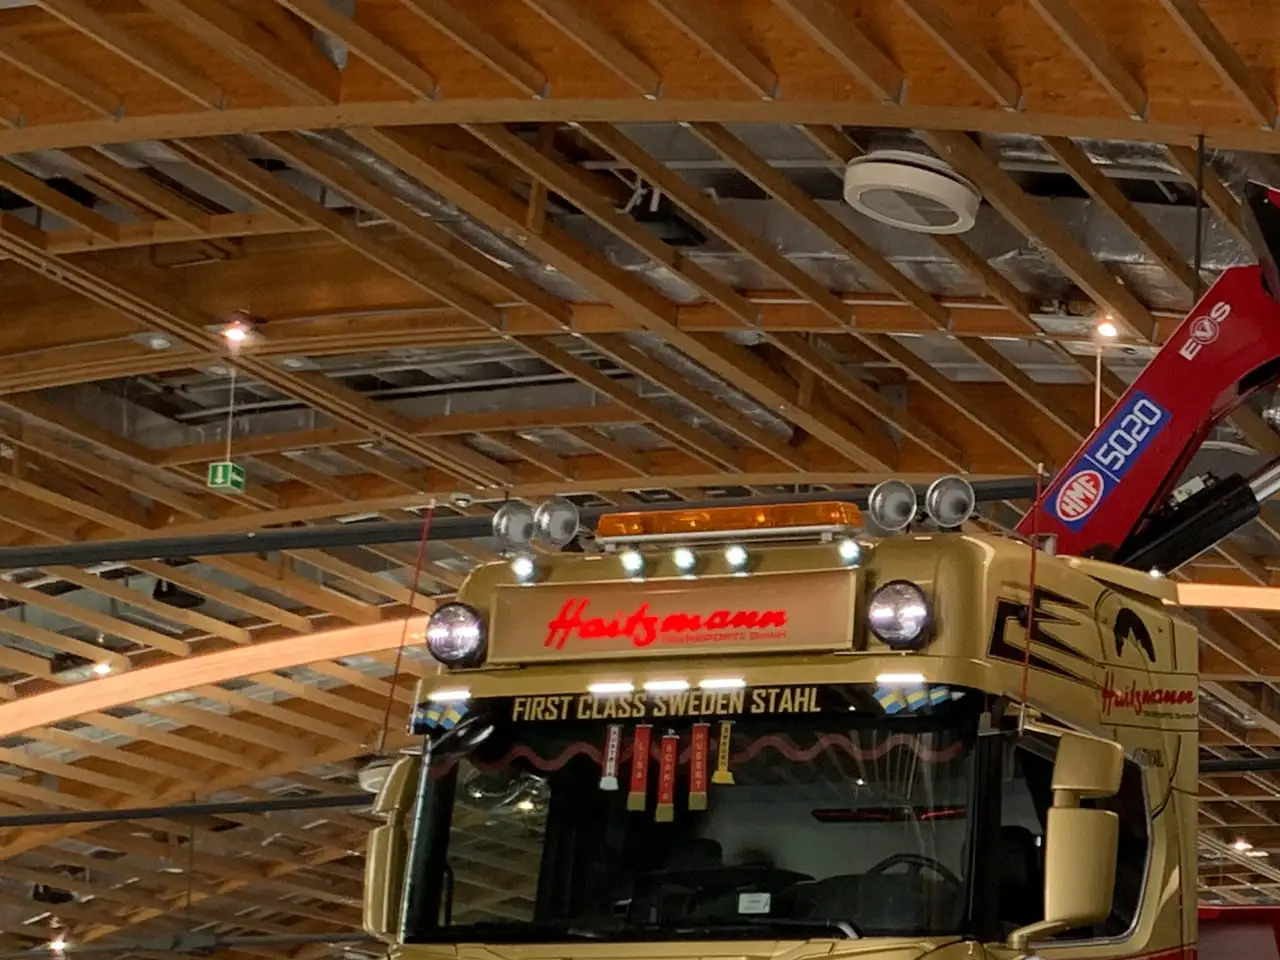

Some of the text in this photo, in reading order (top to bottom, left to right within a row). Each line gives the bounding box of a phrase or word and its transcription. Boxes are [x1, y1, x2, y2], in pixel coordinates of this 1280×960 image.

[1095, 399, 1163, 471] 5020
[1059, 477, 1099, 516] HMF
[544, 596, 787, 650] Haitzmann
[512, 687, 821, 722] FIRST CLASS SWEDEN STAHL
